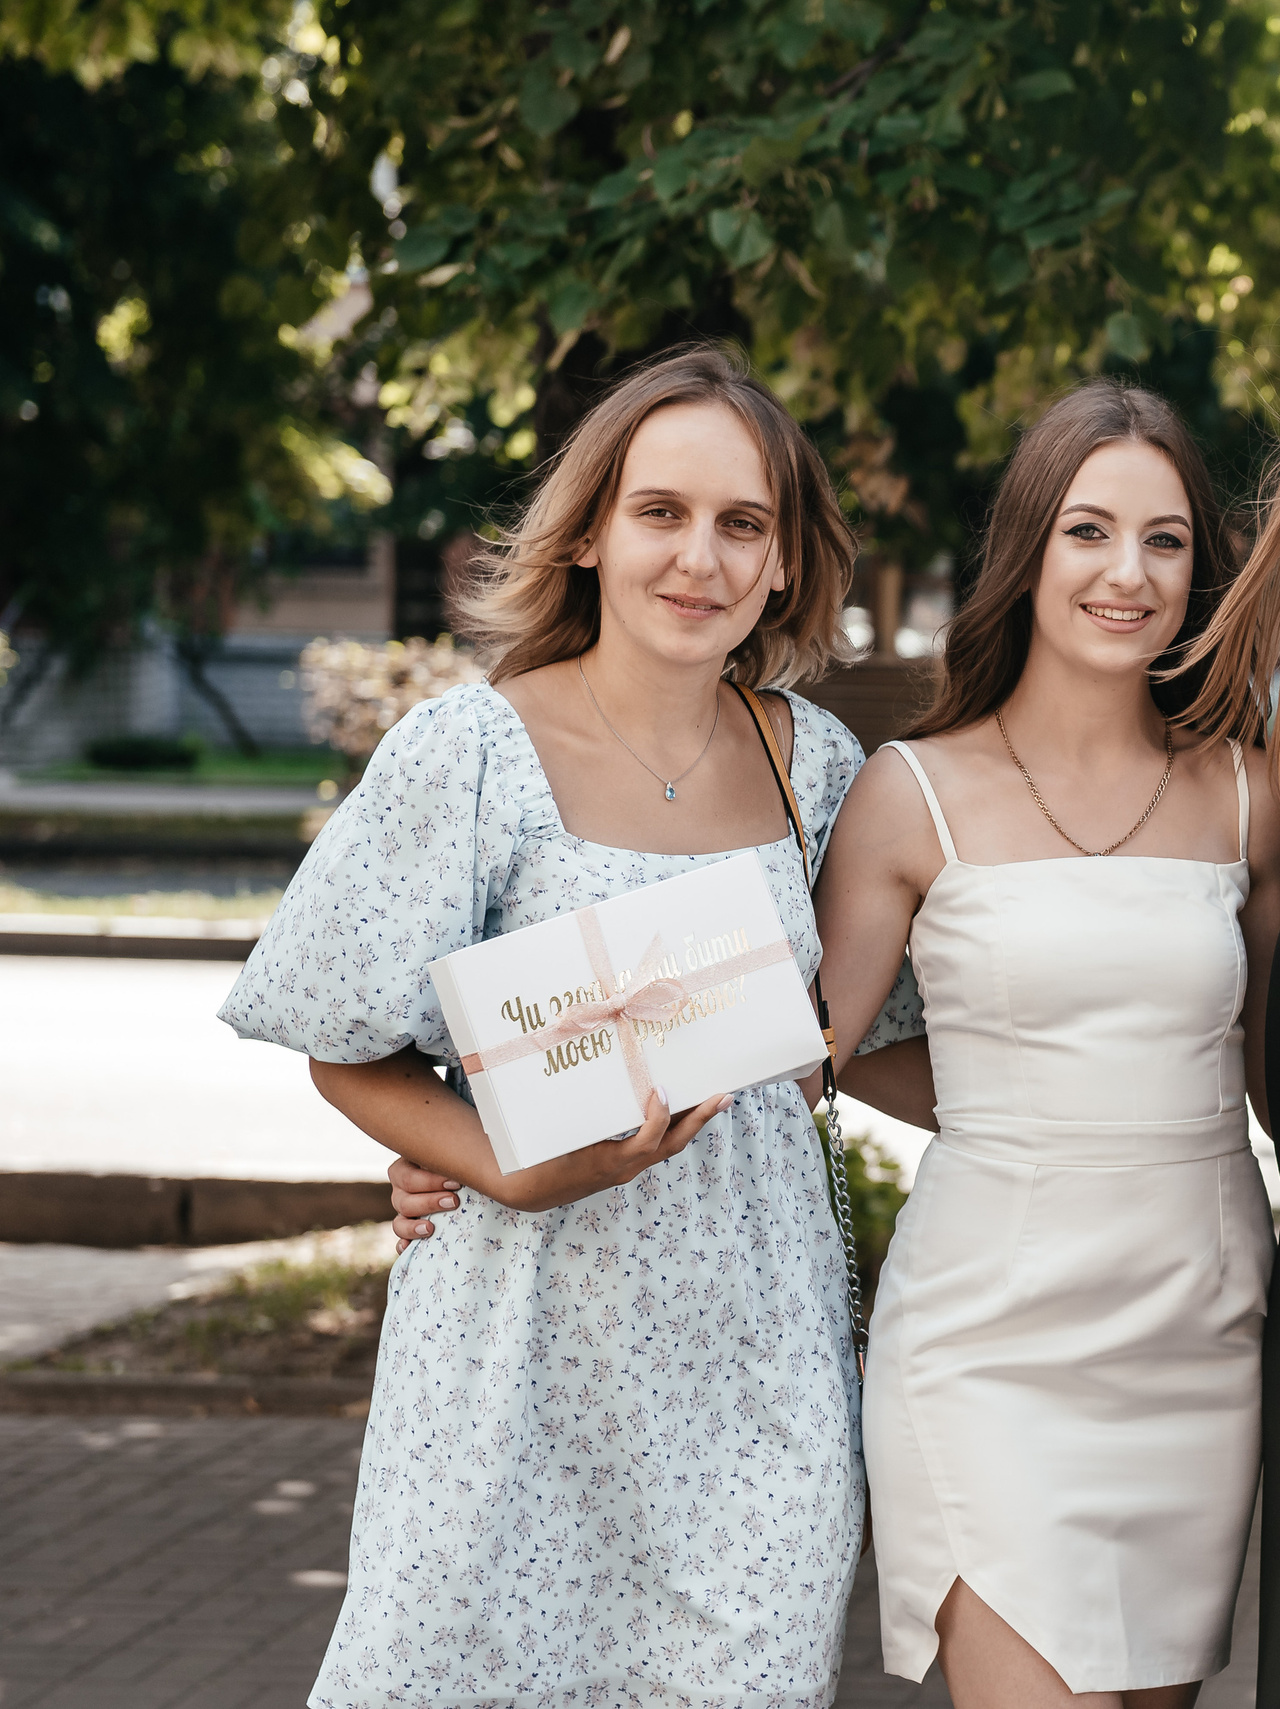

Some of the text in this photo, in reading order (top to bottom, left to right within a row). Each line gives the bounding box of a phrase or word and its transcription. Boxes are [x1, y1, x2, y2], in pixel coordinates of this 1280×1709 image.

[501, 996, 547, 1034] Чи
[682, 929, 753, 972] бити
[542, 1028, 615, 1078] моєю
